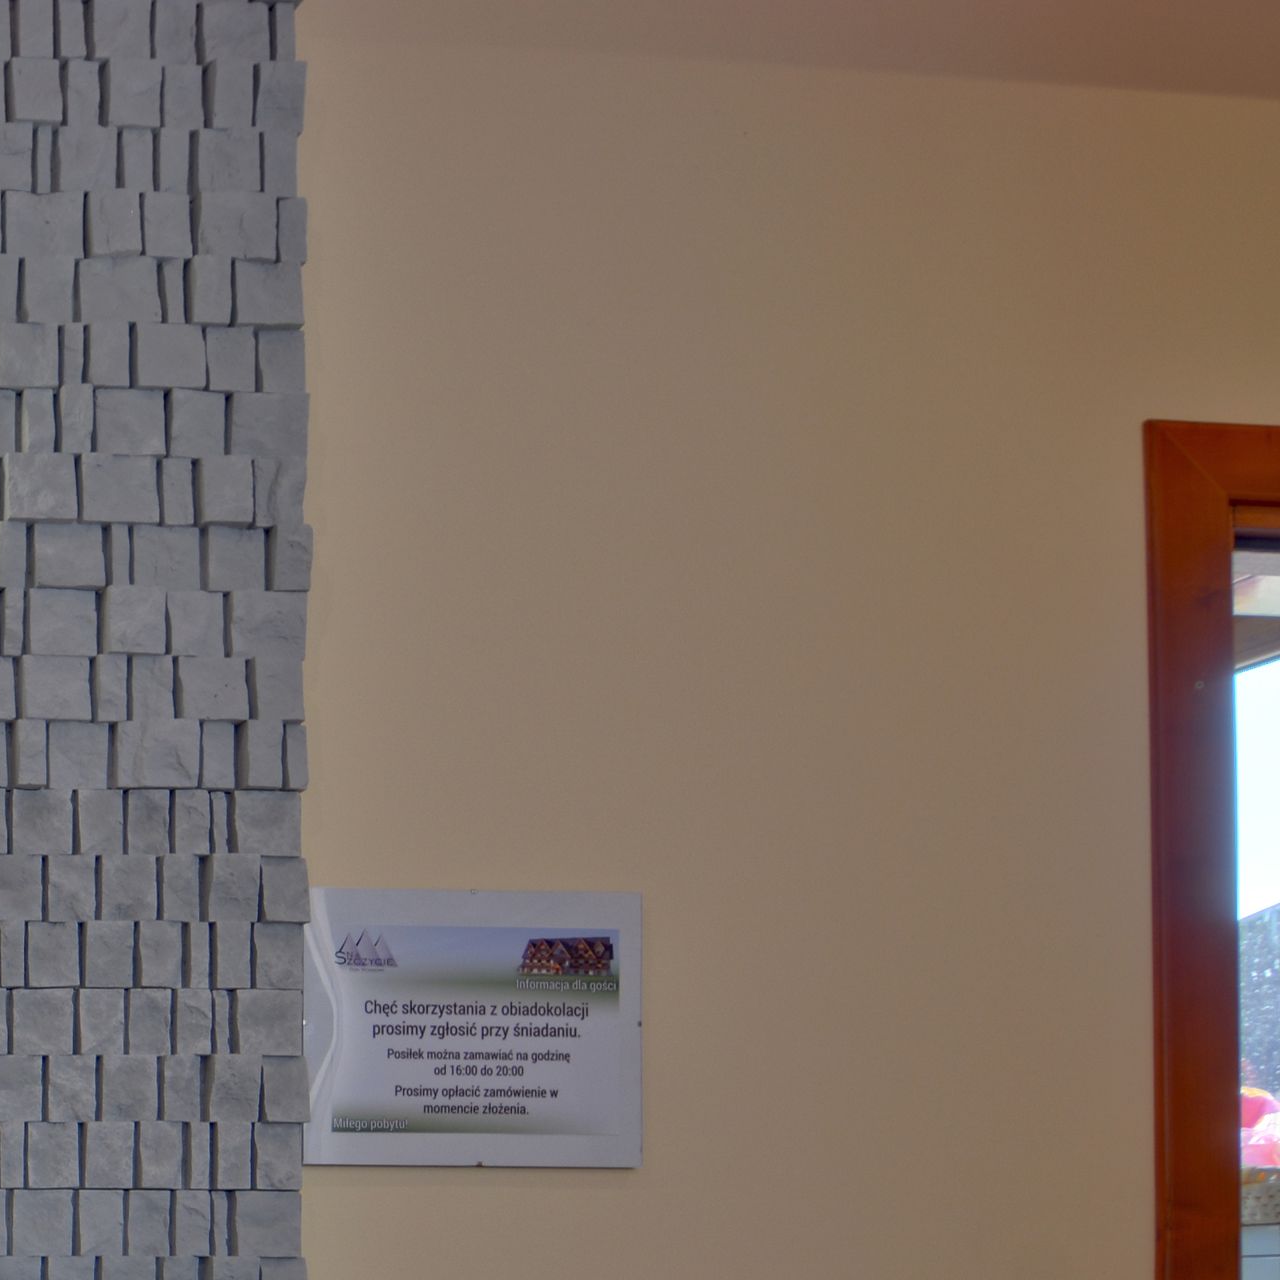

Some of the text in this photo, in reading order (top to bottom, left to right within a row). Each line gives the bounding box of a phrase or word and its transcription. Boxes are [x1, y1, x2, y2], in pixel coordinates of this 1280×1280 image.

[516, 979, 617, 993] Informacja dla gości
[364, 1000, 589, 1019] Chęć skorzystania z obiadokolacji
[372, 1022, 581, 1040] prosimy zgłosić przy śniadaniu.
[387, 1048, 570, 1064] Posiłek można zamawiać na godzinę
[434, 1065, 524, 1077] od 16:00 do 20:00
[394, 1085, 559, 1099] Prosimy opłacić zamówienie w
[423, 1103, 529, 1116] momencie złożenia.
[333, 1118, 409, 1132] Miłego pobytu!
